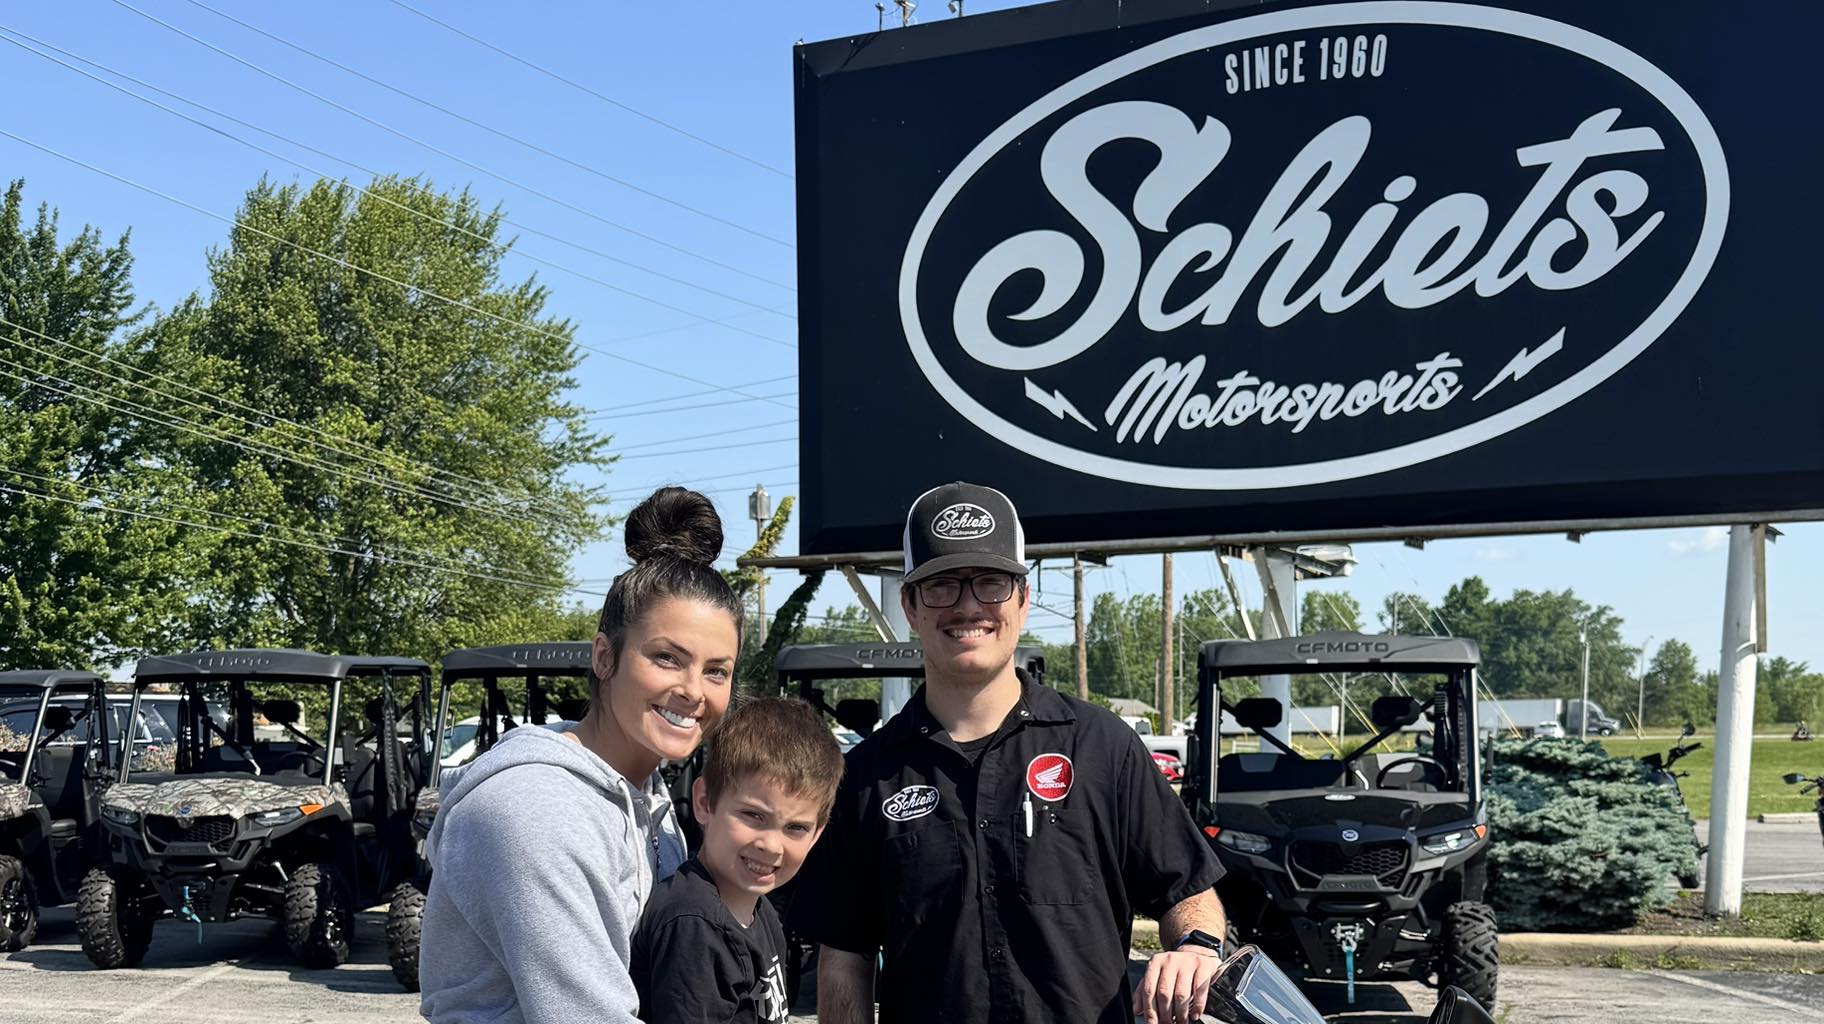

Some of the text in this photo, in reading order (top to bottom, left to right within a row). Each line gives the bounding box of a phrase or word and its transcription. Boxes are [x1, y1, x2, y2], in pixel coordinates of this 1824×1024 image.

[1224, 33, 1388, 95] SINCE 1960
[953, 100, 1665, 371] Schiets
[1104, 351, 1464, 446] Motorsports
[856, 648, 924, 660] CFMOT
[1295, 641, 1389, 655] CFMOTO
